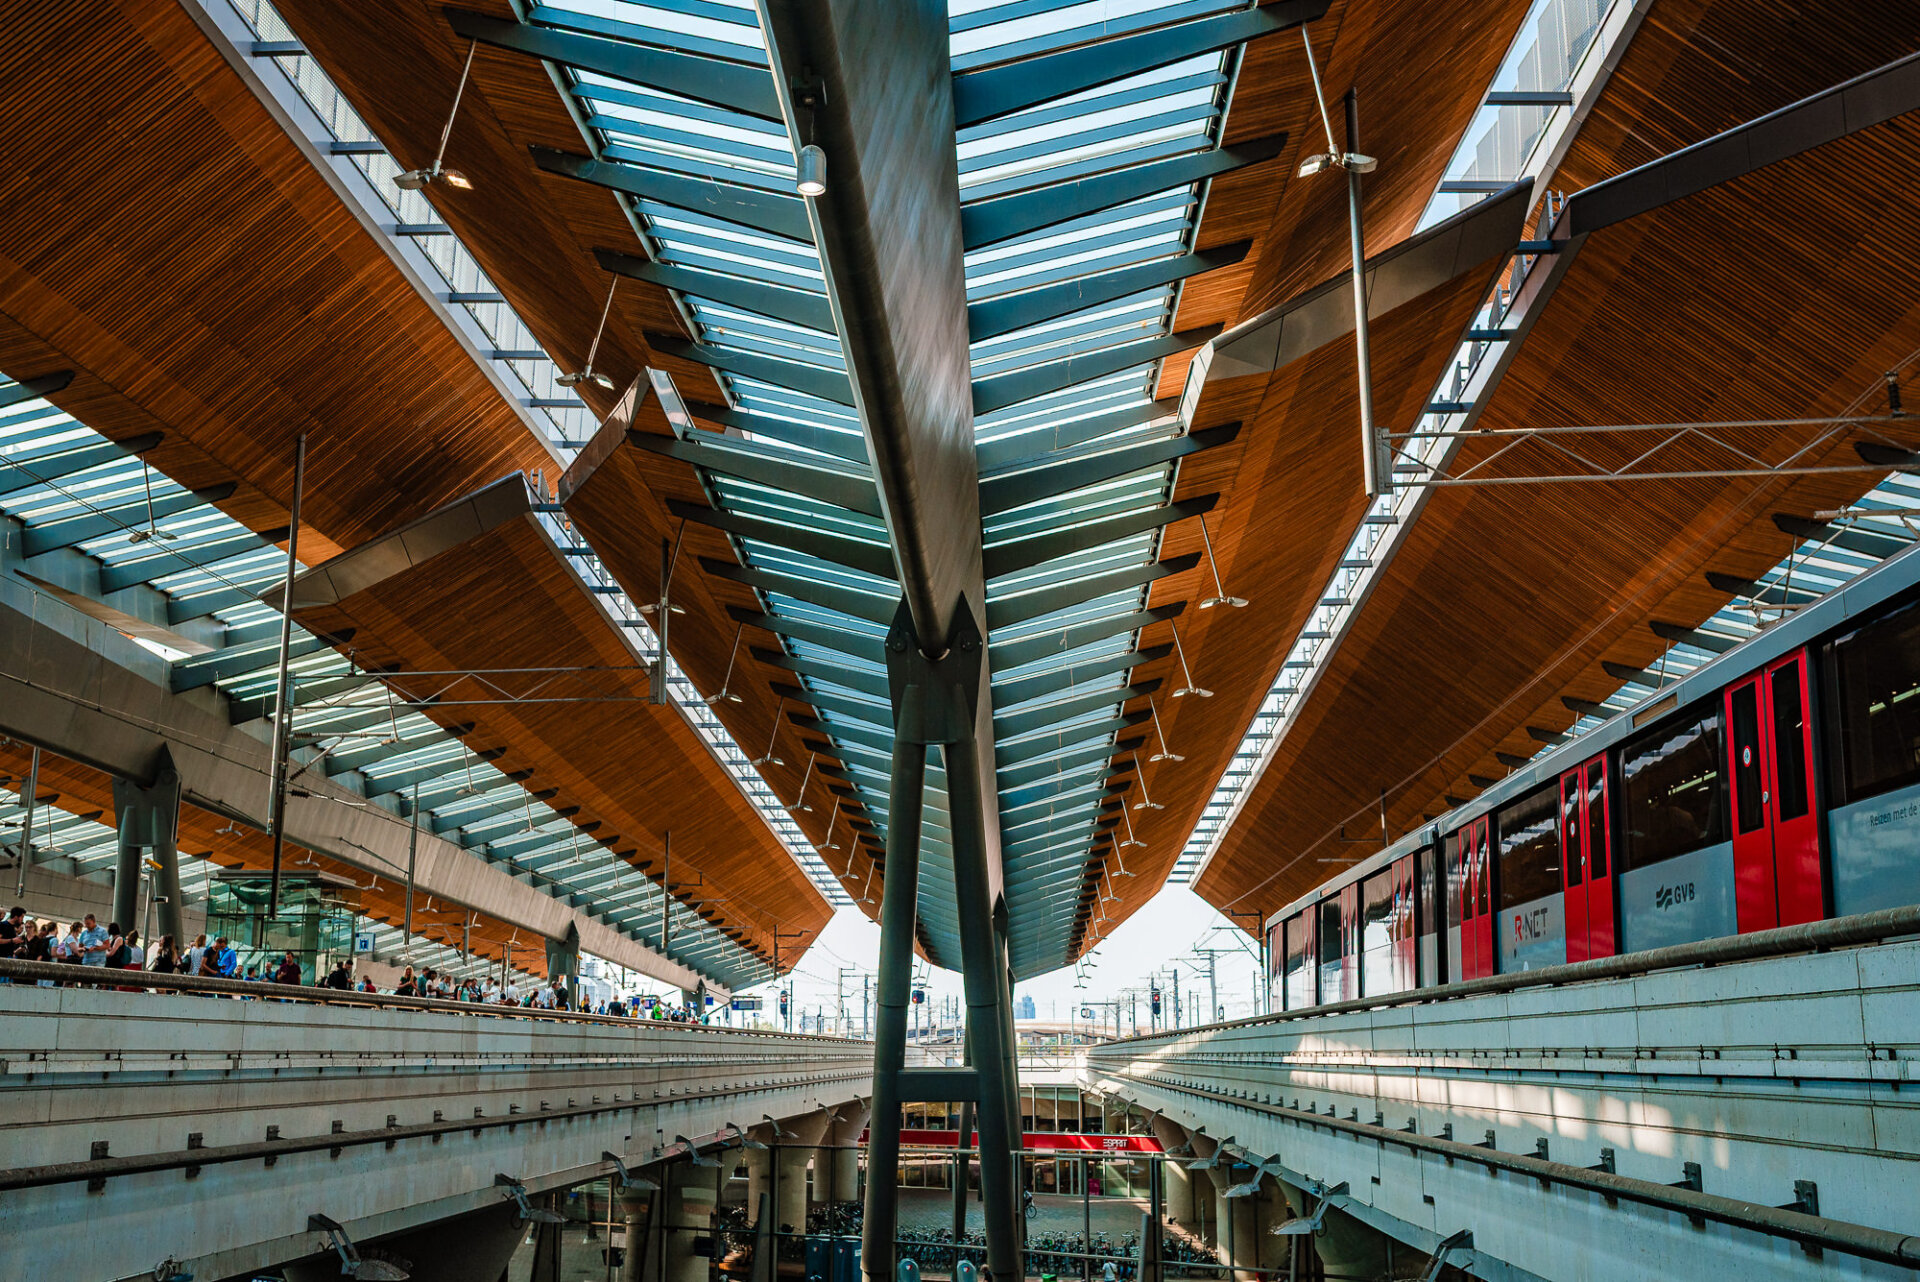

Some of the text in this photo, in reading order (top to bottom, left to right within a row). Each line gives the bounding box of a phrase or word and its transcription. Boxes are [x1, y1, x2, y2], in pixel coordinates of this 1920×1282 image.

[1870, 812, 1891, 827] Reizen
[1893, 806, 1907, 821] met
[1909, 803, 1918, 817] de
[1674, 882, 1695, 904] GVB
[1103, 1138, 1128, 1148] ESPRIT
